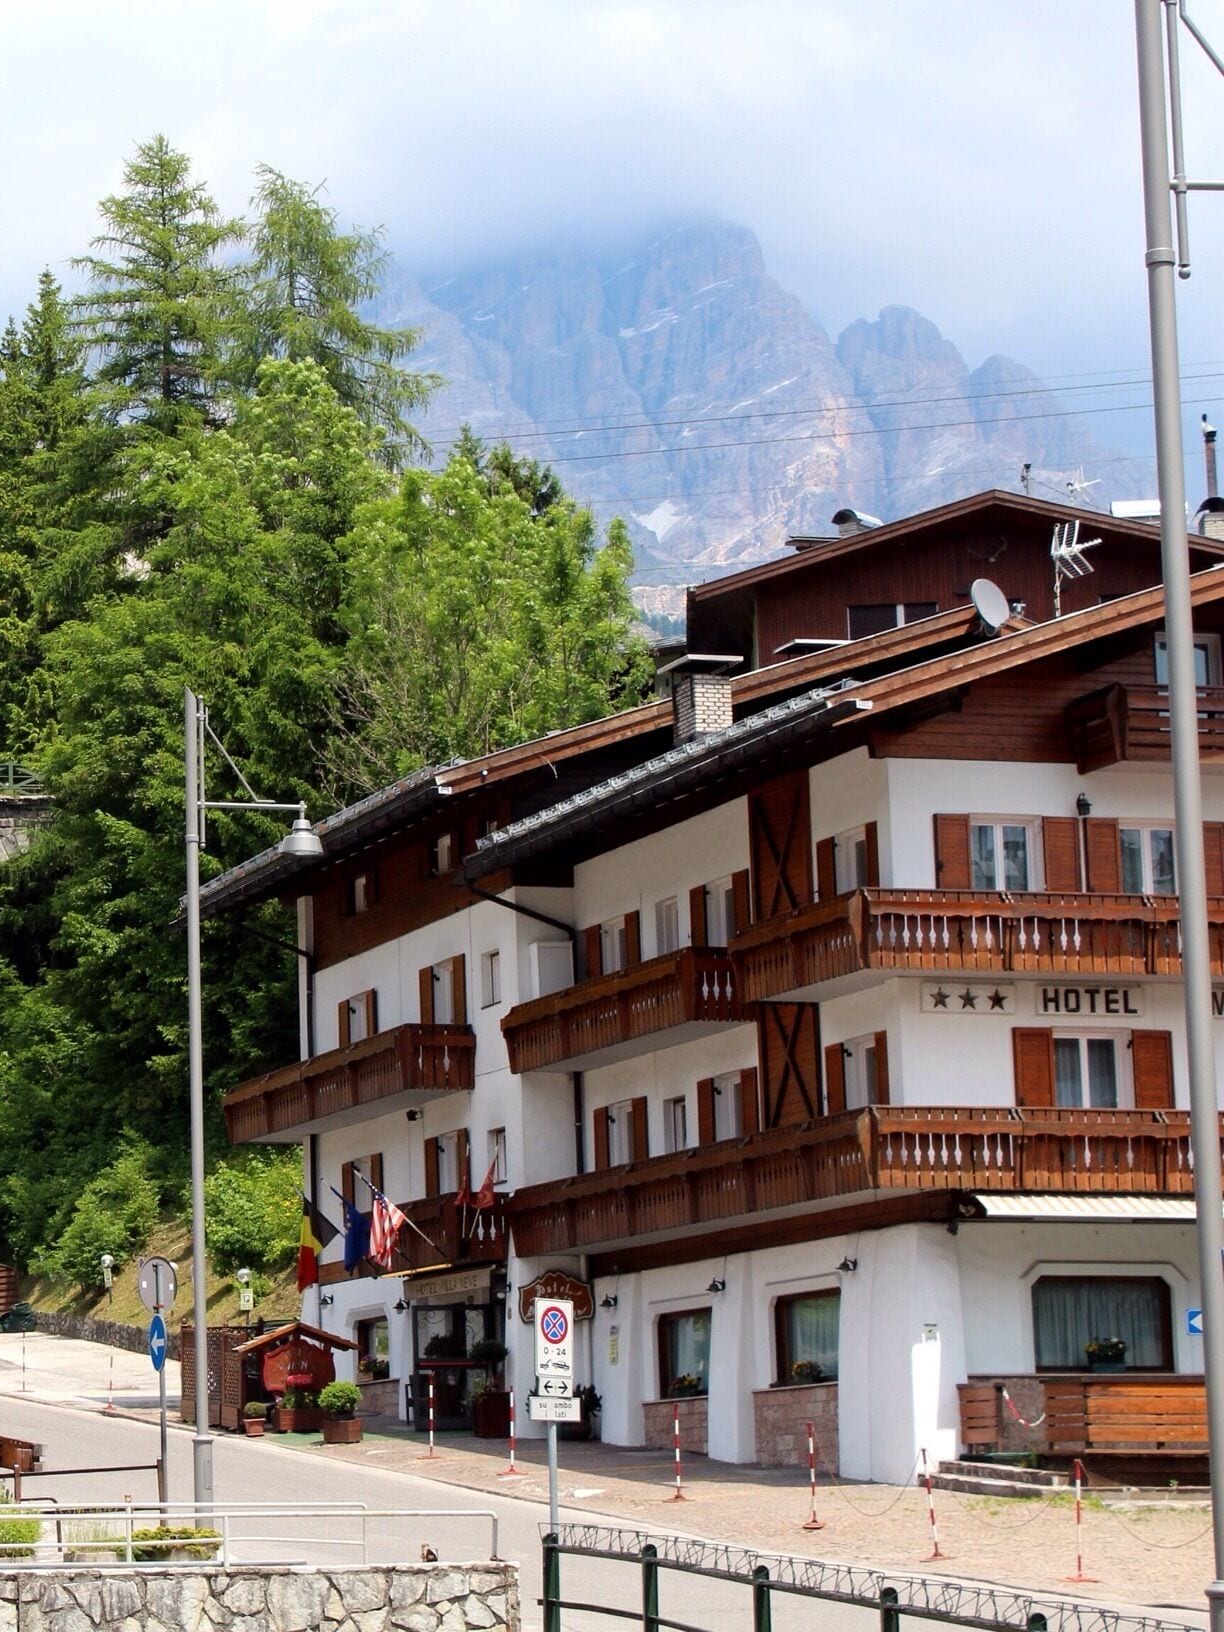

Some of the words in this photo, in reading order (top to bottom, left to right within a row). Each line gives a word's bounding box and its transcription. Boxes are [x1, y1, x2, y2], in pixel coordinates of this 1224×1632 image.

[1042, 988, 1138, 1014] HOTEL
[416, 1283, 437, 1296] HOTEL
[543, 1347, 549, 1355] 0
[556, 1347, 566, 1356] 24
[554, 1401, 572, 1409] ambo
